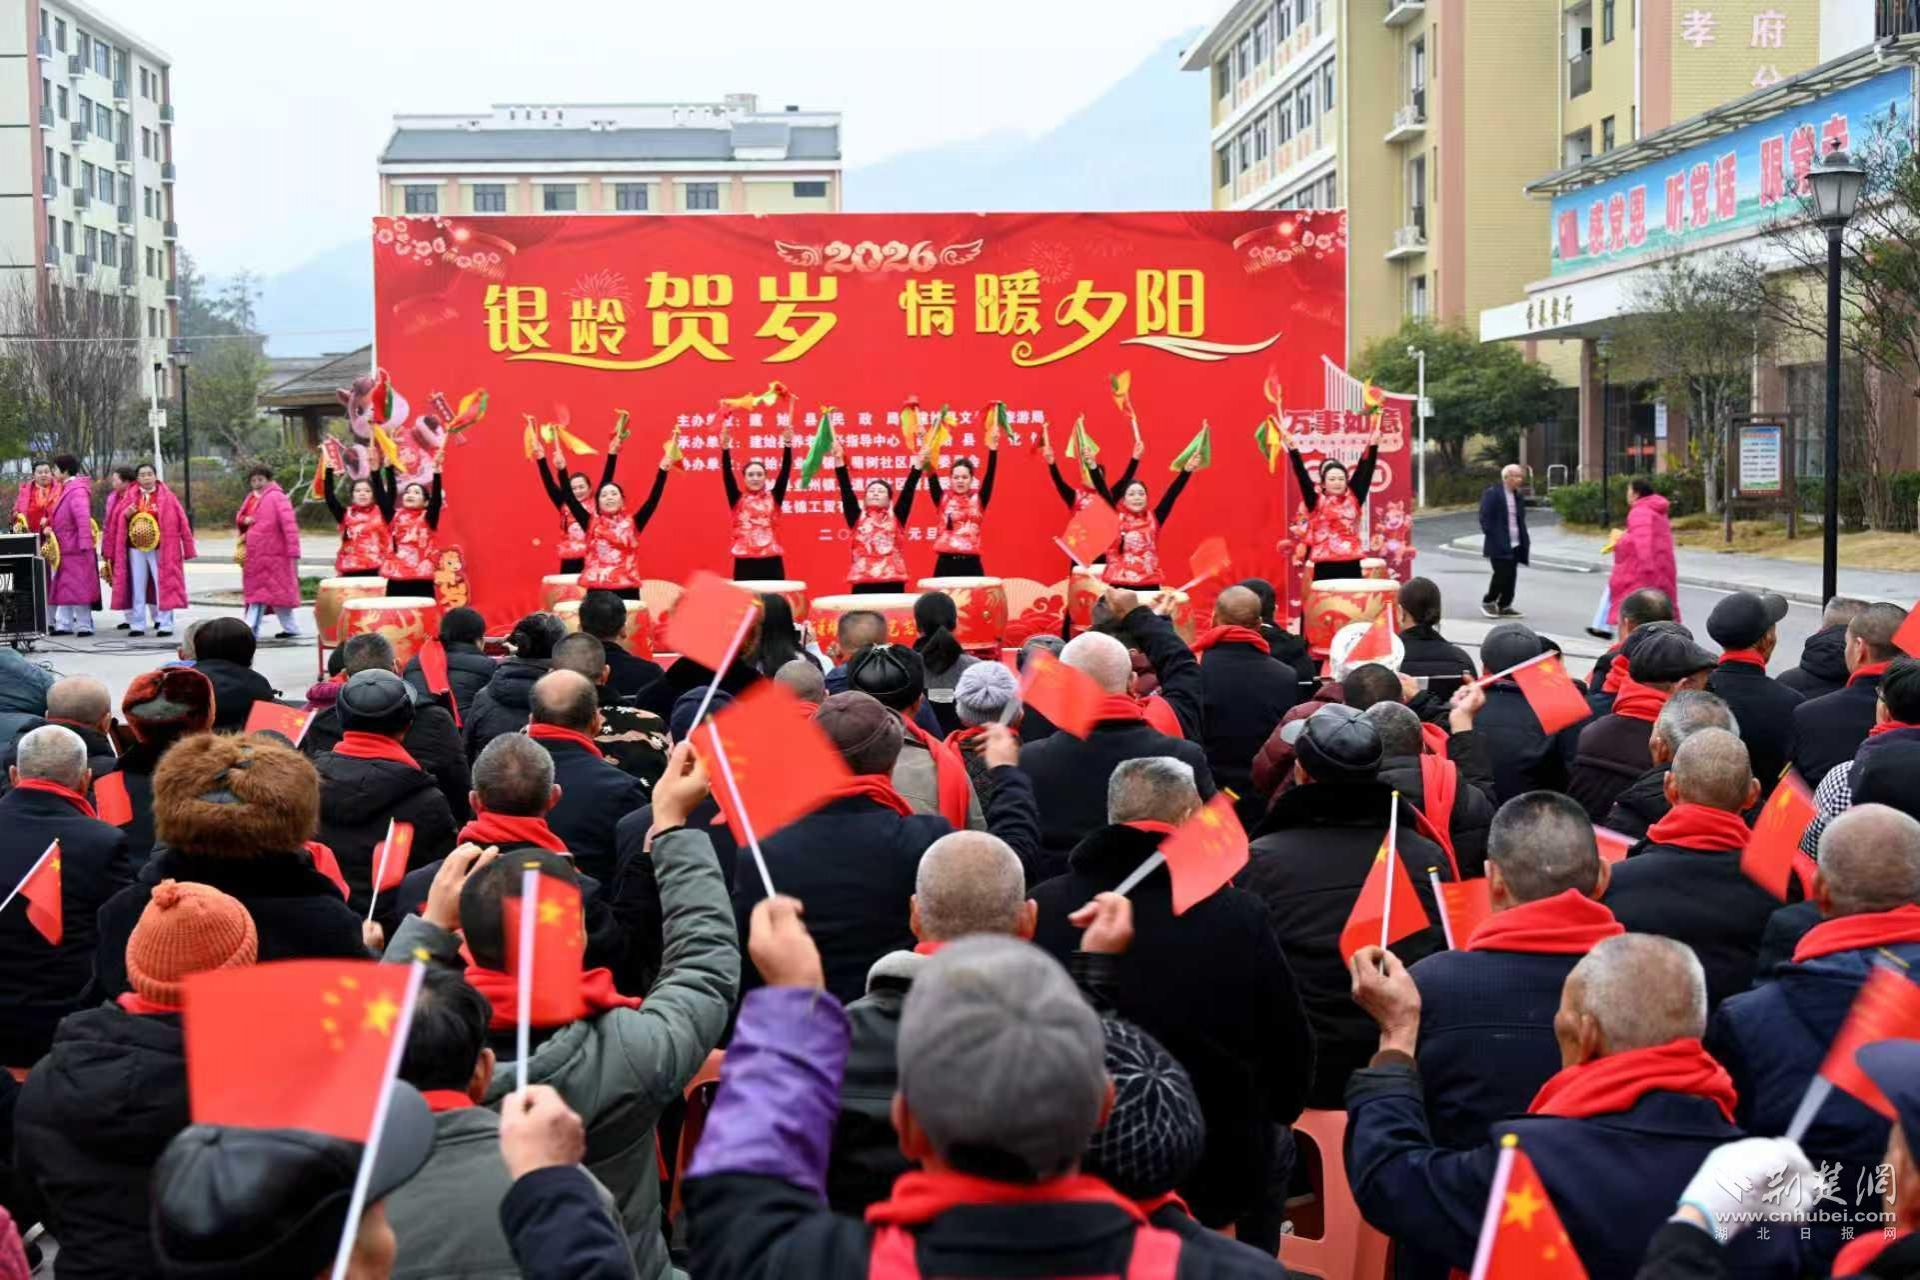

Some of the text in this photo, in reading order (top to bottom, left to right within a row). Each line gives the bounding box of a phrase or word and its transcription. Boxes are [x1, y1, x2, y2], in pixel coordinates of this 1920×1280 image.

[823, 239, 939, 273] 2026
[483, 268, 1206, 371] 银龄贺岁 情暖夕阳
